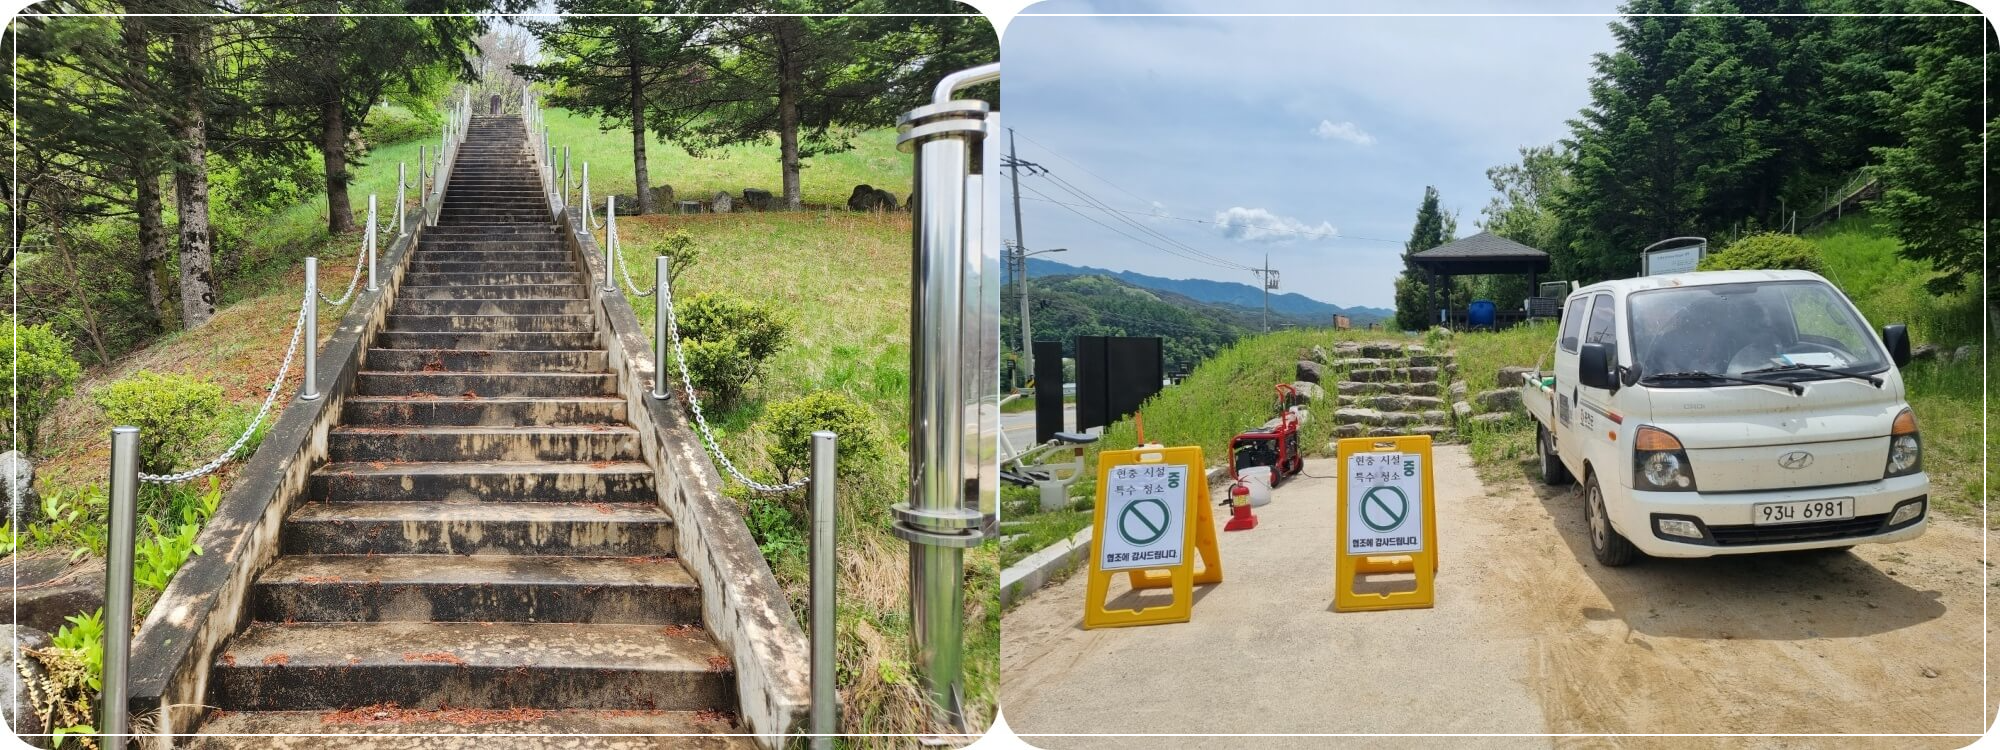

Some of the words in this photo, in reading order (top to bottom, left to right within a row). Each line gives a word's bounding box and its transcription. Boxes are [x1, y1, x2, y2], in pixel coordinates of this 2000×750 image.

[1380, 454, 1400, 465] 시설
[1144, 466, 1165, 478] 시설
[1354, 472, 1376, 483] 특수
[1114, 485, 1137, 496] 특수
[1763, 505, 1795, 521] 93나
[1803, 501, 1843, 518] 6981
[1352, 538, 1374, 548] 협조에
[1106, 552, 1130, 563] 협조에
